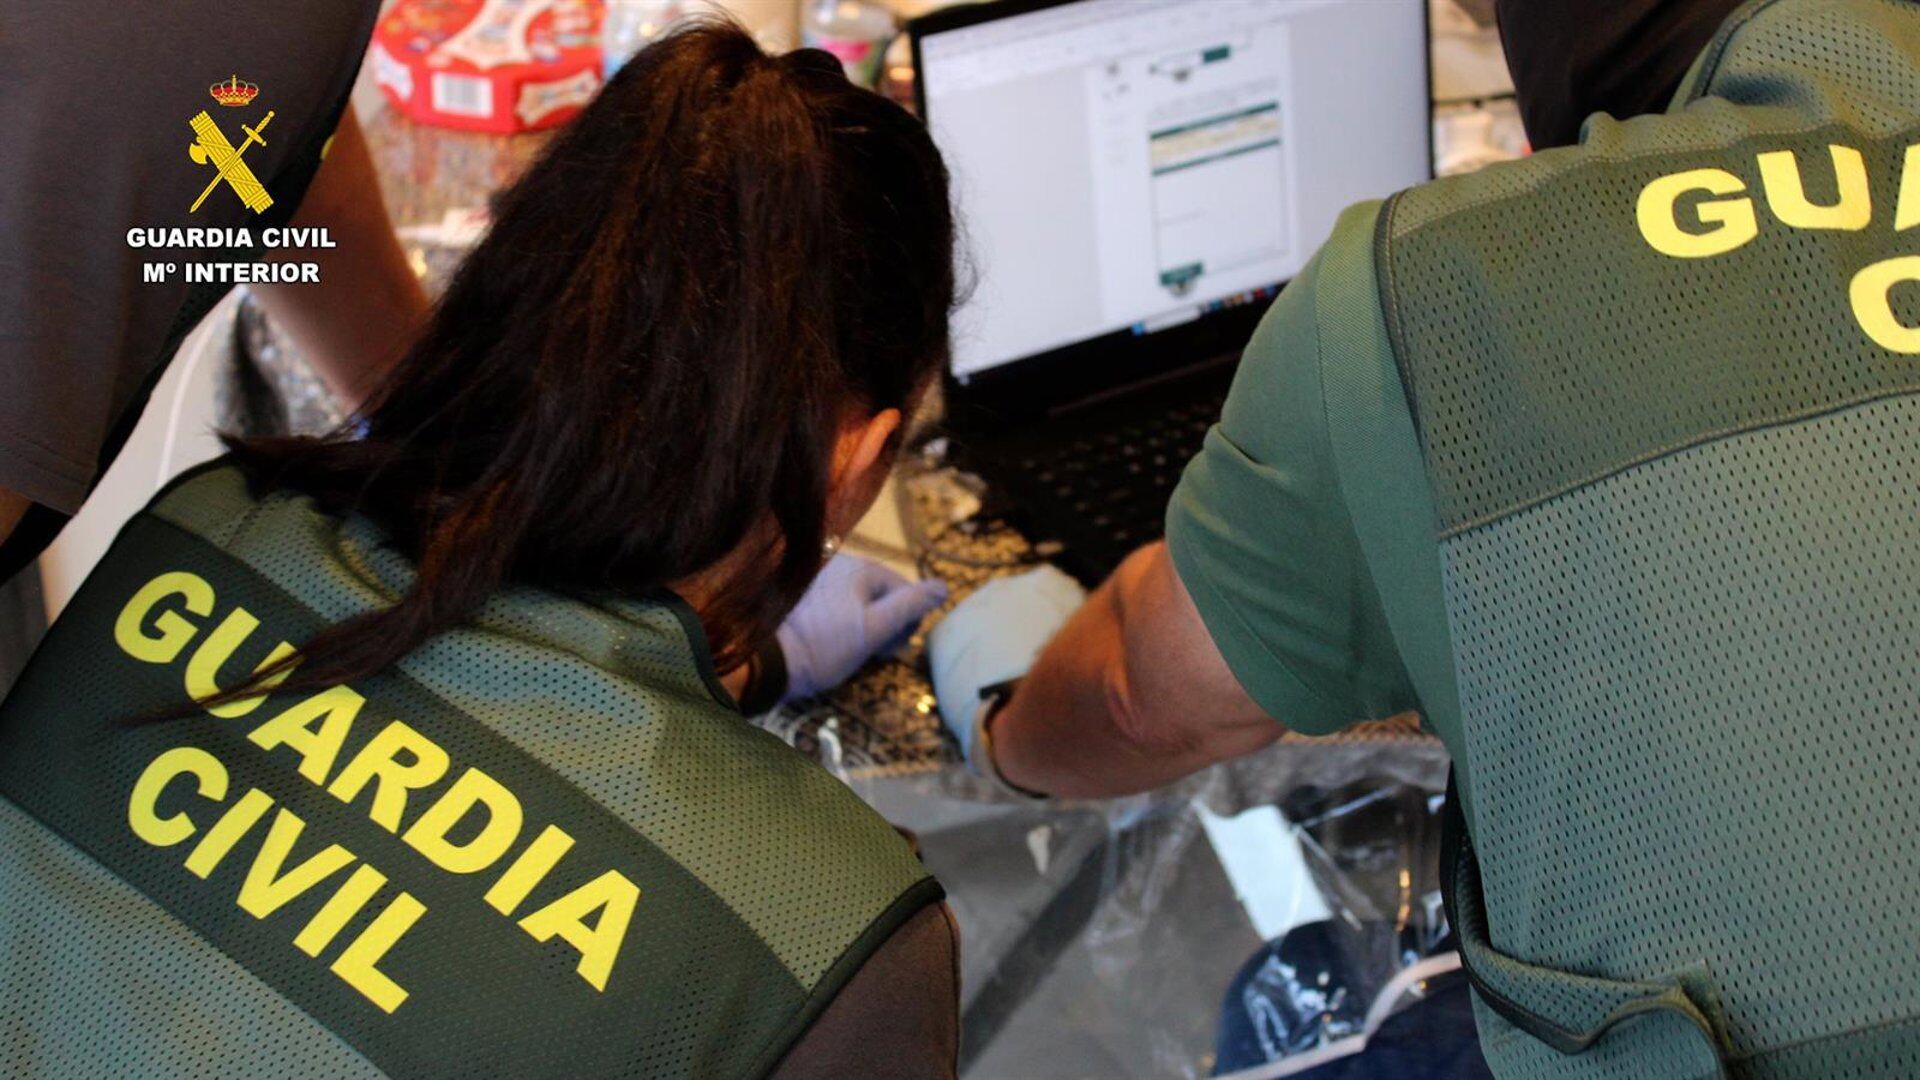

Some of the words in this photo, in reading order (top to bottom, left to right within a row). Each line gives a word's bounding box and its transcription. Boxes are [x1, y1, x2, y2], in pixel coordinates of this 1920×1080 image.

[1636, 143, 1920, 258] GU
[114, 571, 641, 993] GUARDIA
[128, 747, 427, 1015] CIVIL
